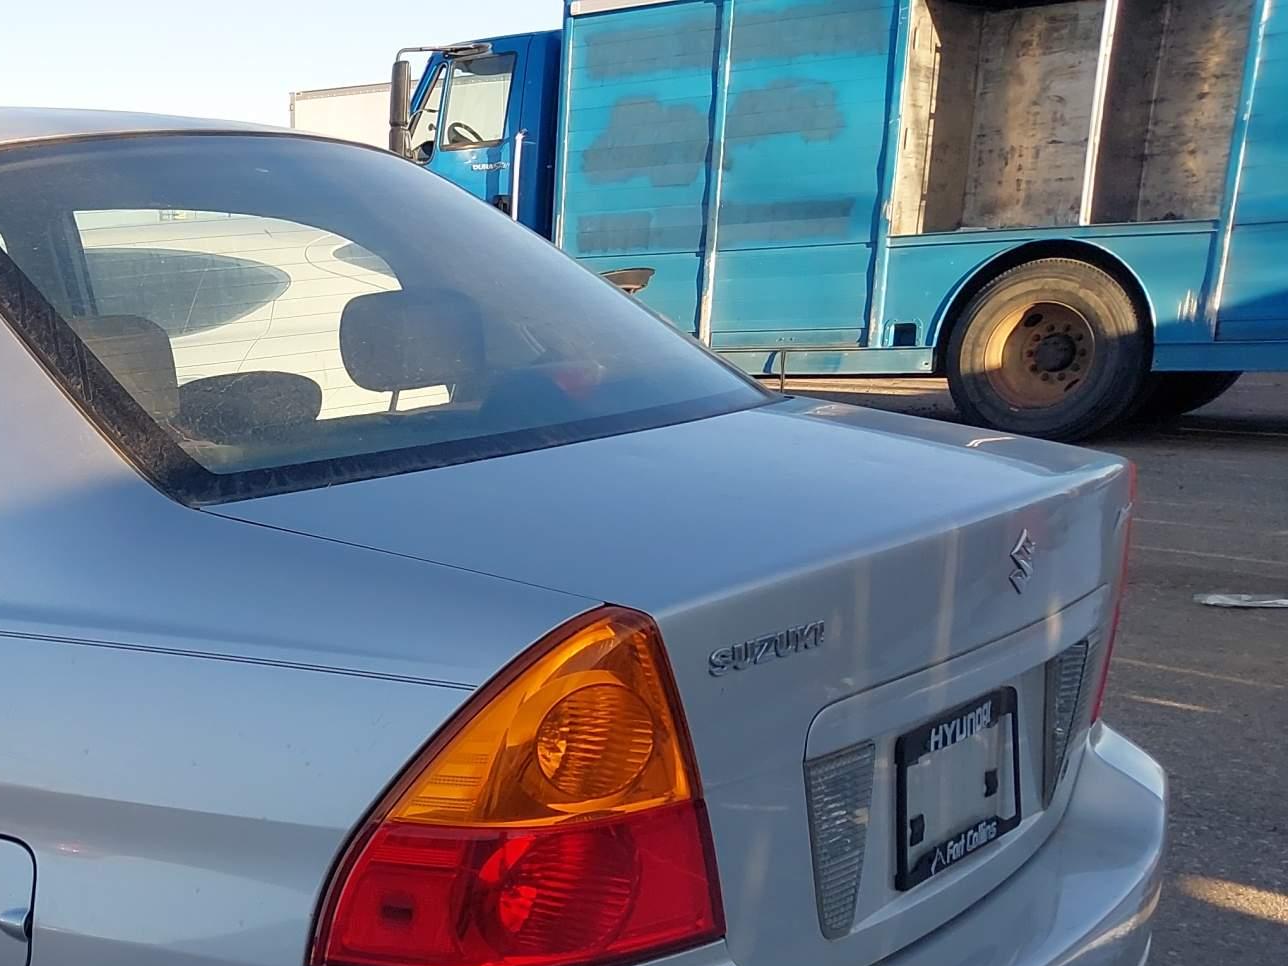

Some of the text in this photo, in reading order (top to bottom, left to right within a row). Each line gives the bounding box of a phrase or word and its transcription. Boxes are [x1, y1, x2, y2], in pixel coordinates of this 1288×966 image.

[708, 620, 825, 678] SUZUKI
[930, 700, 993, 752] HYUNDAI
[947, 821, 998, 864] Fort Collins
